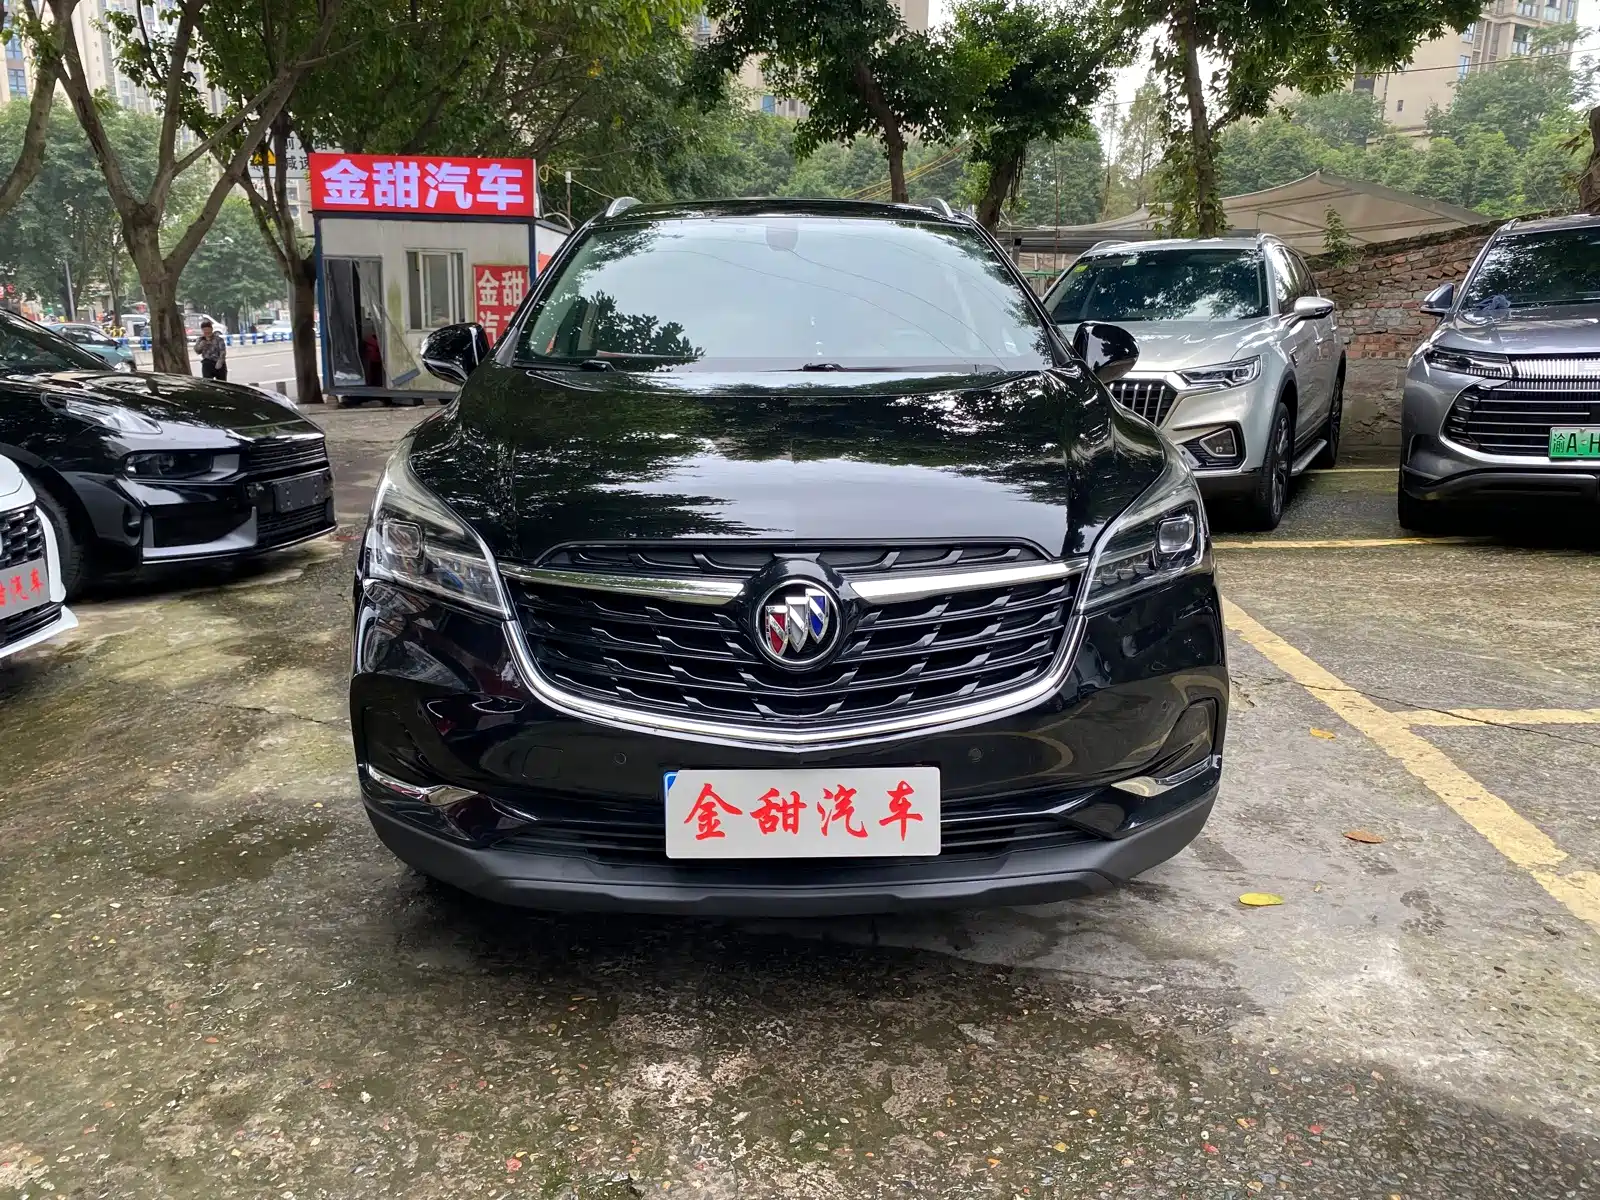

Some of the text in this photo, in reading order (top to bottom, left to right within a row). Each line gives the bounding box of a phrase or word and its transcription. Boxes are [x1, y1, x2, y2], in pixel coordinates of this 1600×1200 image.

[320, 158, 524, 211] 金甜汽车
[477, 269, 525, 307] 金甜
[478, 310, 514, 345] 汽
[683, 780, 924, 842] 金甜汽车
